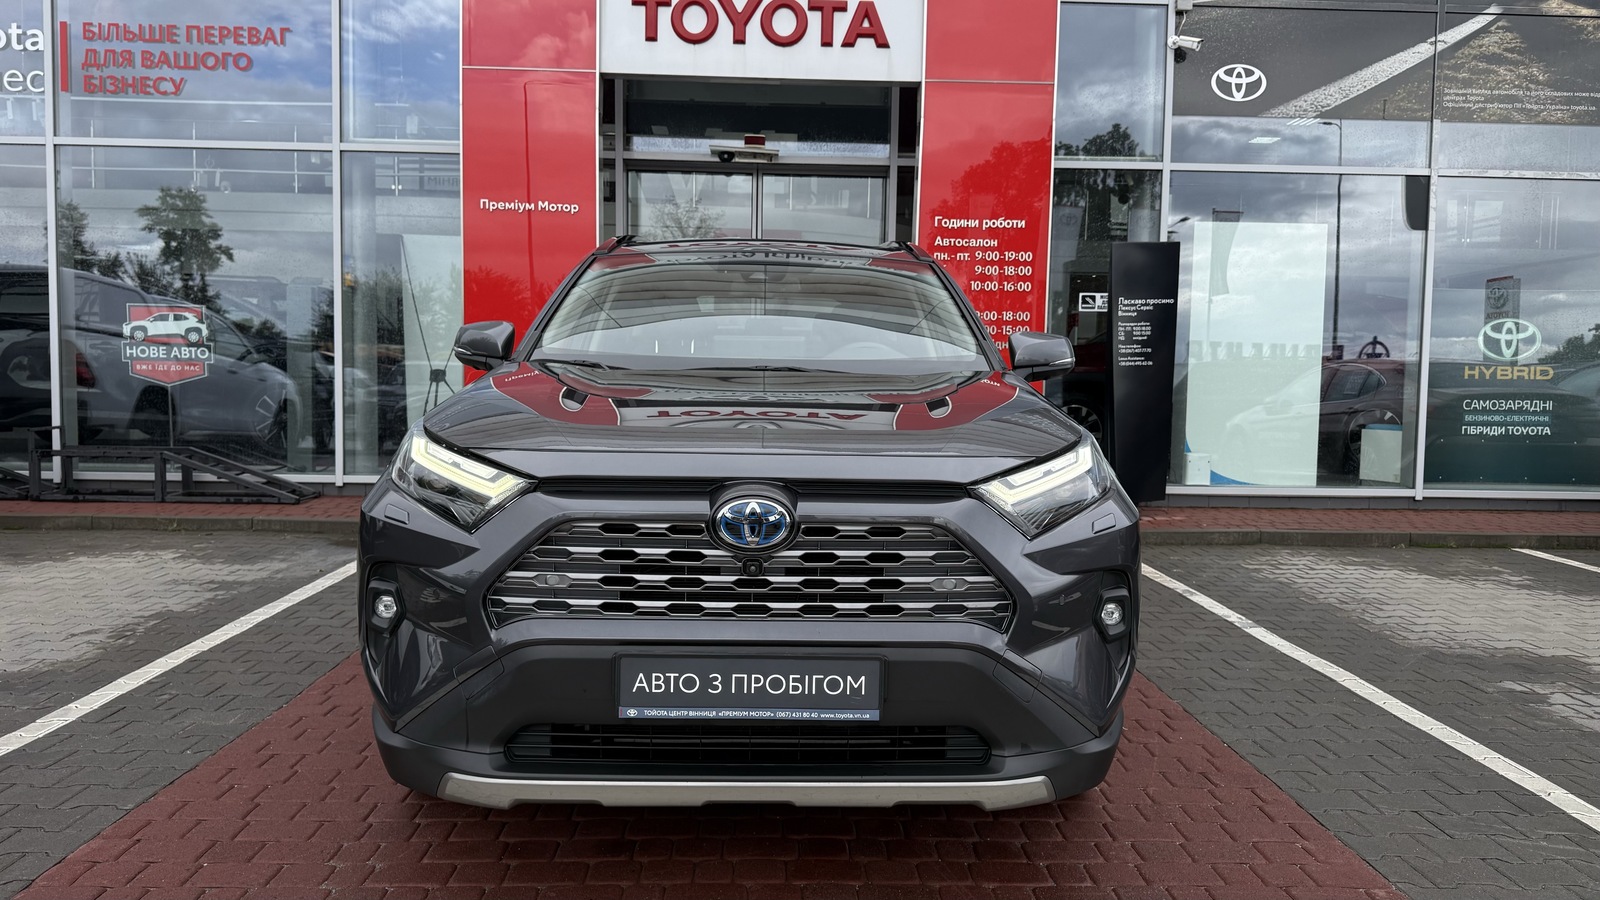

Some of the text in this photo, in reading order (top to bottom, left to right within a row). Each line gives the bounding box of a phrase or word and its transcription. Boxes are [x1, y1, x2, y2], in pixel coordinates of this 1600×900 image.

[631, 0, 890, 48] TOYOTA
[82, 22, 293, 46] БІЛЬШЕ ПЕРЕВАГ
[81, 49, 254, 71] ДЛЯ ВАШОГО
[82, 74, 187, 96] БІЗНЕСУ
[480, 198, 579, 214] Преміум Мотор
[934, 216, 1025, 230] Години роботи
[934, 236, 998, 247] Автосалон
[975, 251, 1033, 262] 9:00-19:00
[974, 265, 1032, 276] 9:00-18:00
[970, 281, 1032, 292] 10:00-16:00
[126, 346, 209, 359] НОВЕ АВТО
[1463, 365, 1554, 380] HYBRID
[1462, 399, 1553, 412] САМОЗАРЯДНІ
[1461, 425, 1551, 436] ГІБРИДИ TOYOTA
[632, 672, 866, 696] АВТО З ПРОБІГОМ
[644, 708, 668, 716] ТОЙОТА
